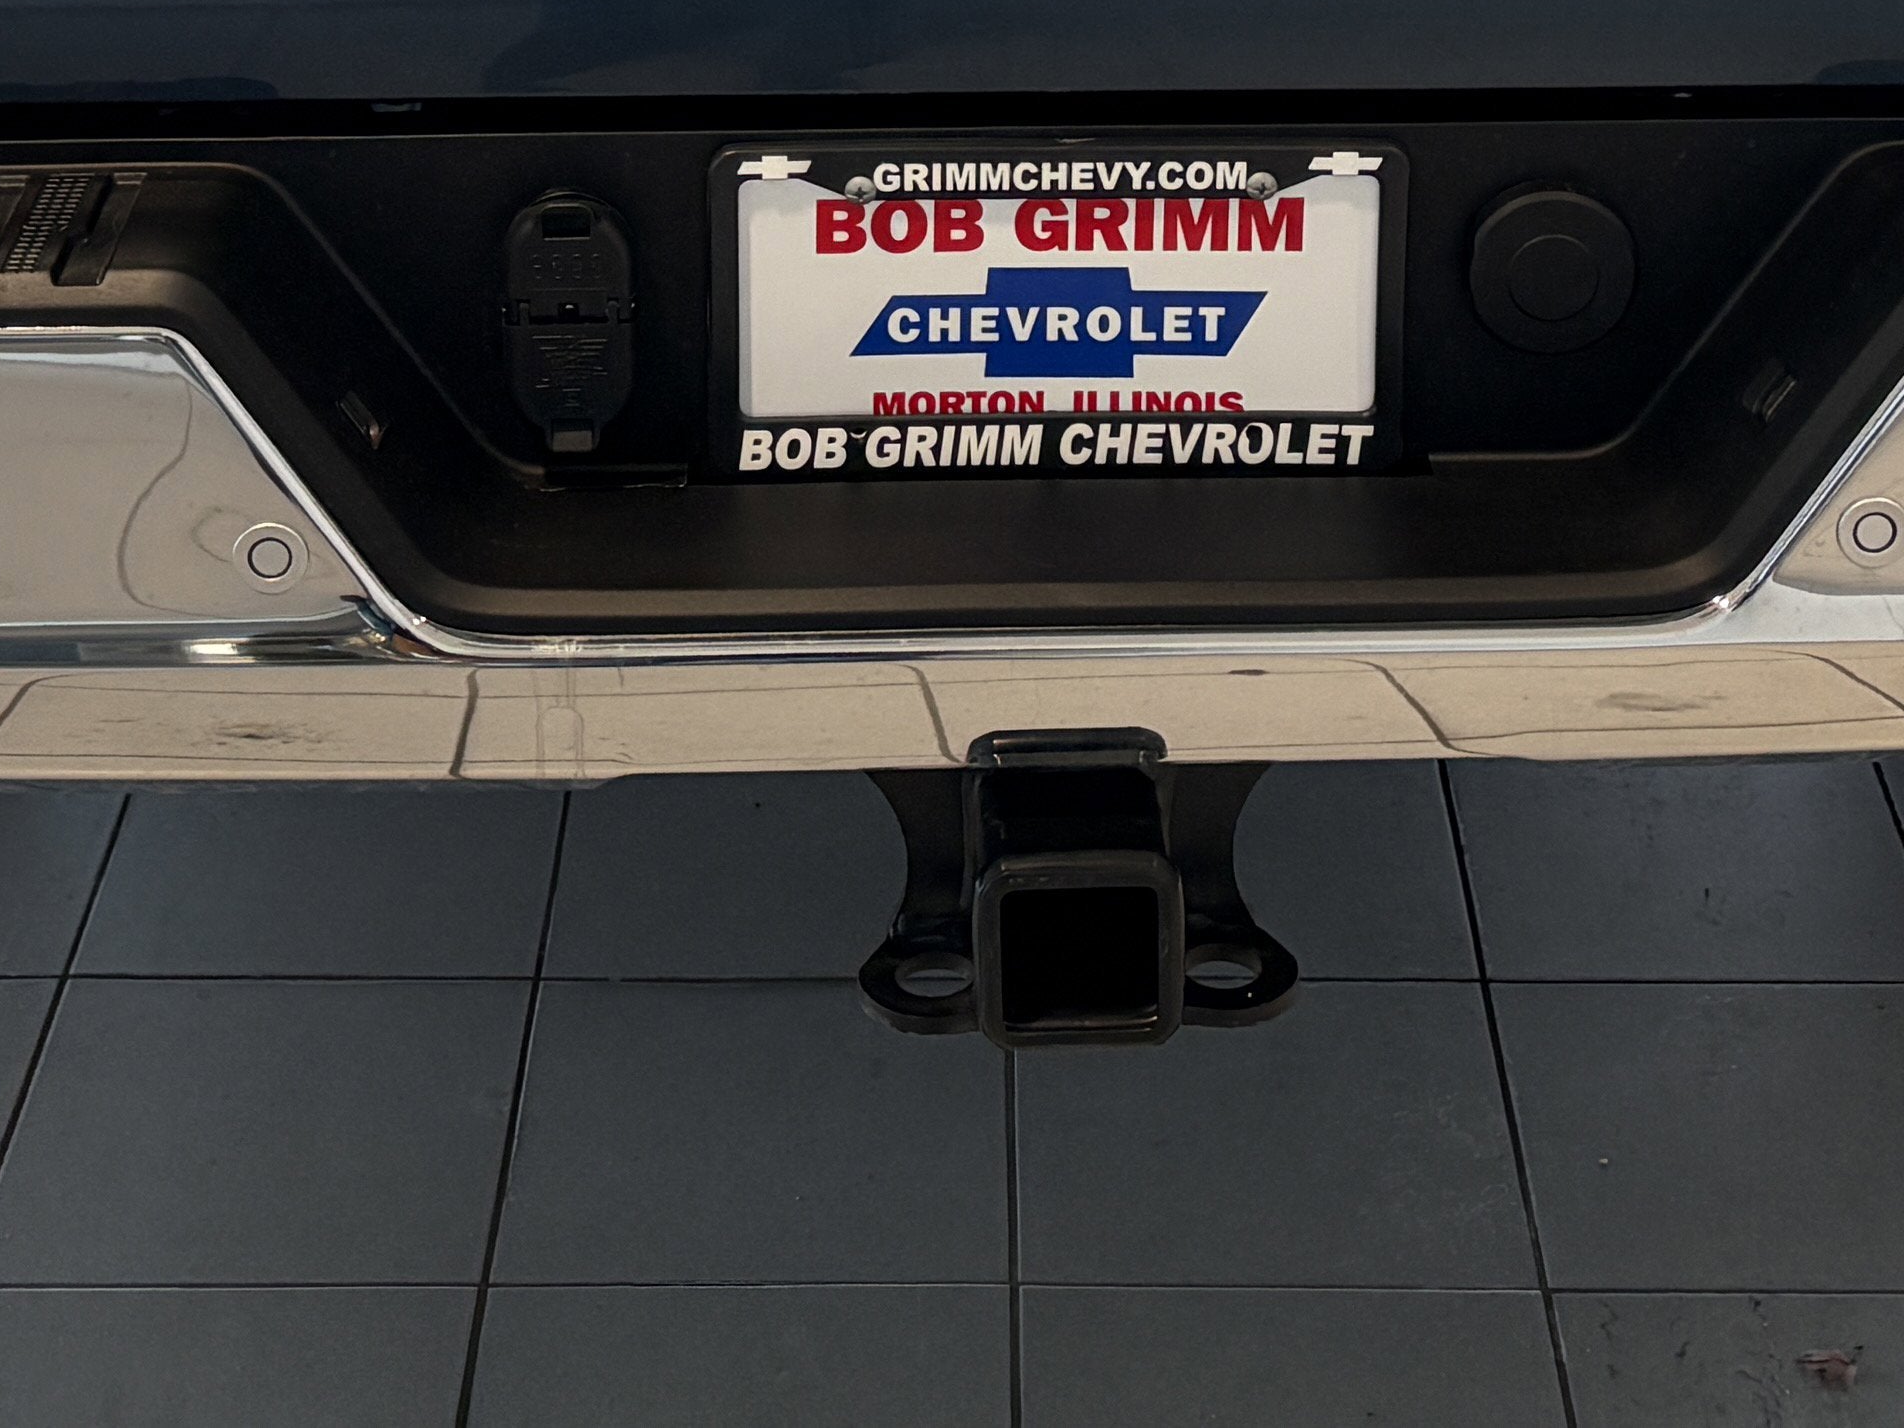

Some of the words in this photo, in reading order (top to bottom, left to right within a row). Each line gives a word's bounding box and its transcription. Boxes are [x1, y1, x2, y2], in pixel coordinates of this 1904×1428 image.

[872, 160, 1249, 193] GRIMMCHEVY.COM
[815, 198, 985, 255] BOB
[1013, 196, 1306, 253] GRIMM
[886, 305, 1227, 344] CHEVROLET
[872, 390, 1045, 416] MORTON
[738, 428, 849, 473] BOB
[863, 424, 1041, 470] GRIMM
[1058, 423, 1374, 467] CHEVROLET
